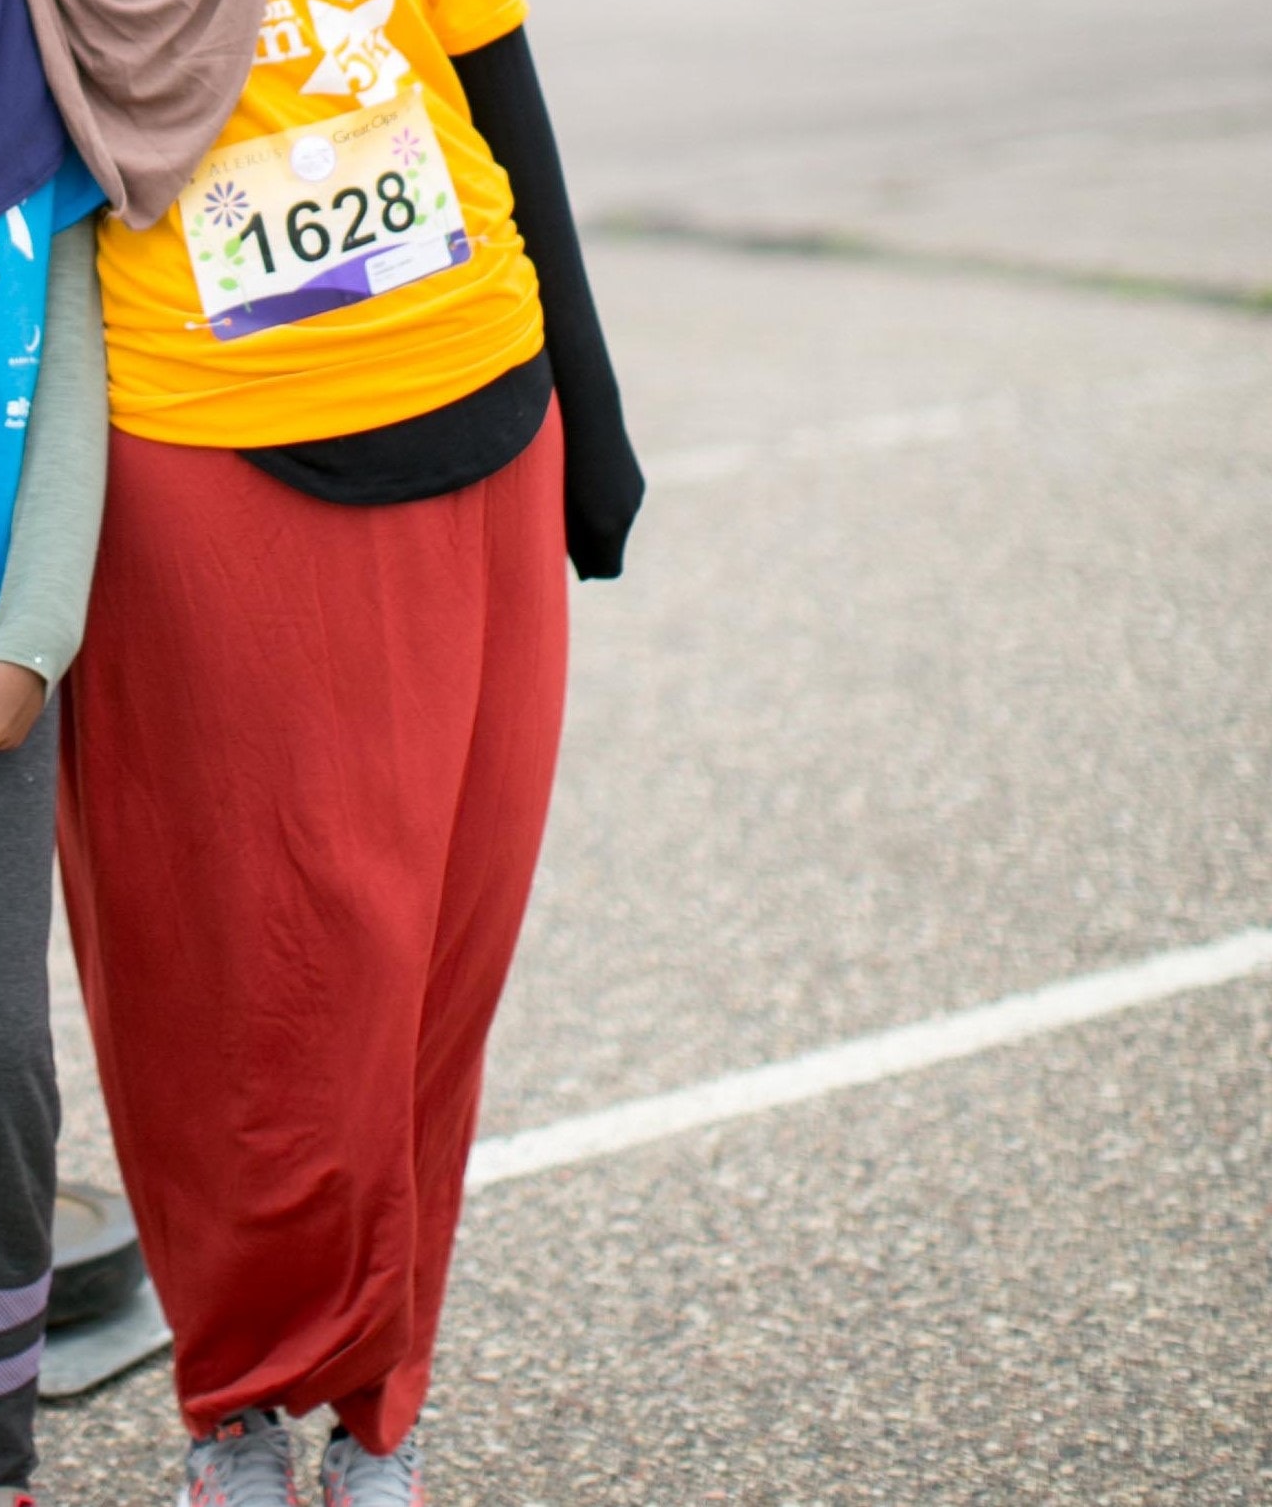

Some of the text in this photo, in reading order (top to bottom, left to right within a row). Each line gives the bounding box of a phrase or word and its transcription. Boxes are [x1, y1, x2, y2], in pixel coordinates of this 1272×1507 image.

[332, 125, 371, 145] Great
[371, 110, 400, 130] Clips
[239, 171, 416, 274] 1628
